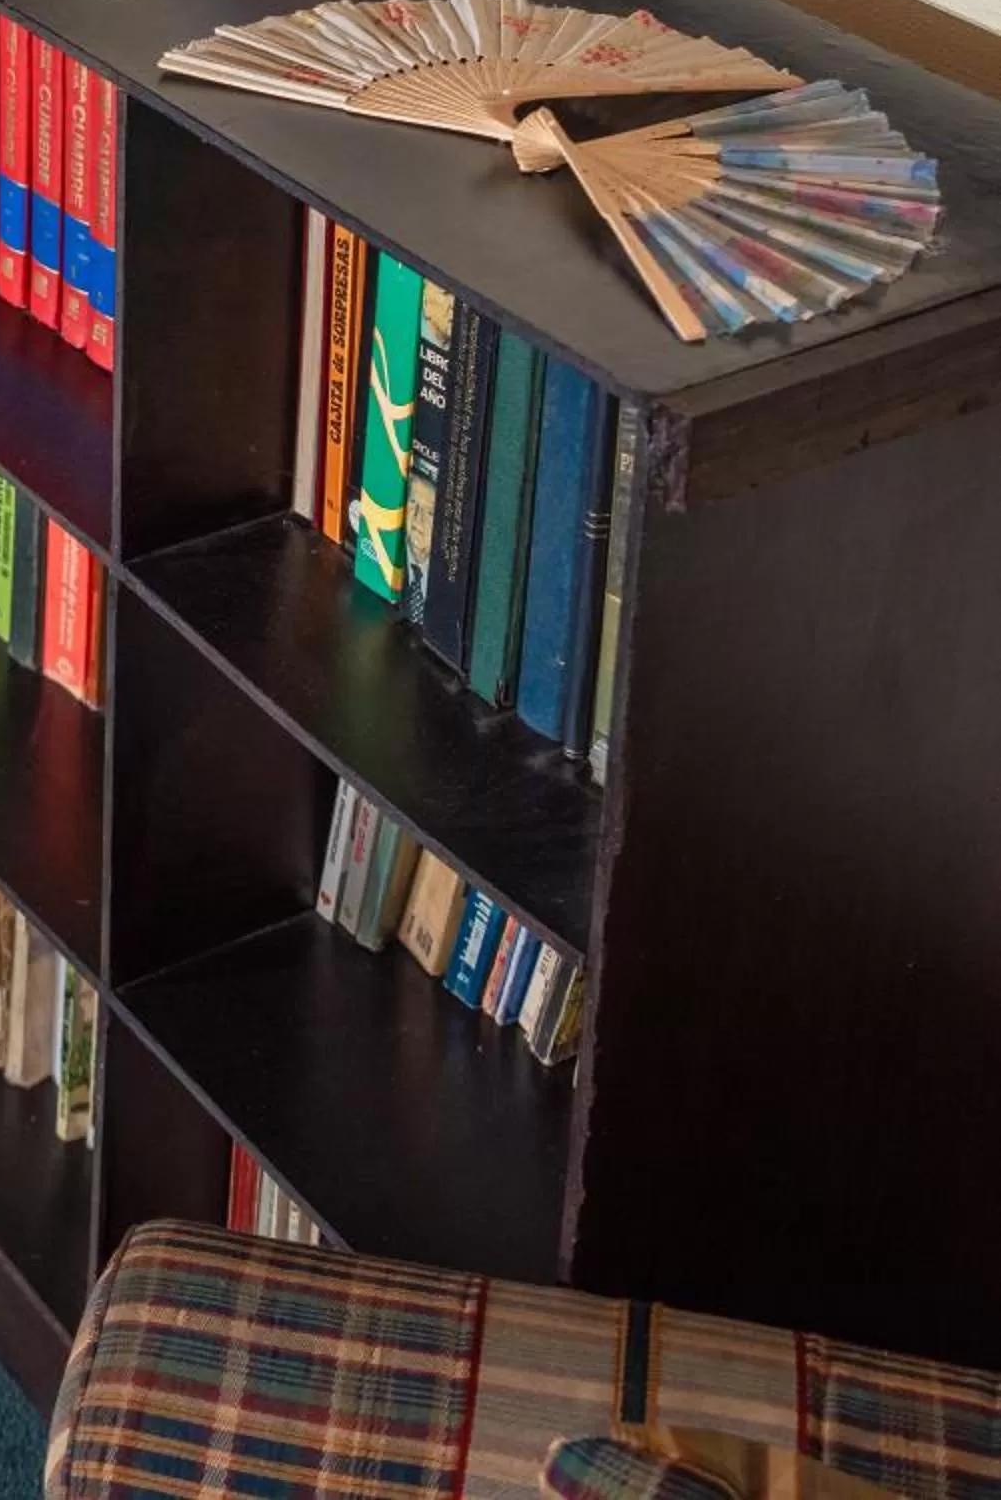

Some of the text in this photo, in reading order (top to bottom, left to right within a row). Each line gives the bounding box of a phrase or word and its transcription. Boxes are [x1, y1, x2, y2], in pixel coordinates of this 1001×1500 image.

[70, 103, 87, 209] CUMBRE
[330, 238, 350, 445] CAJITA de SORPRESAS
